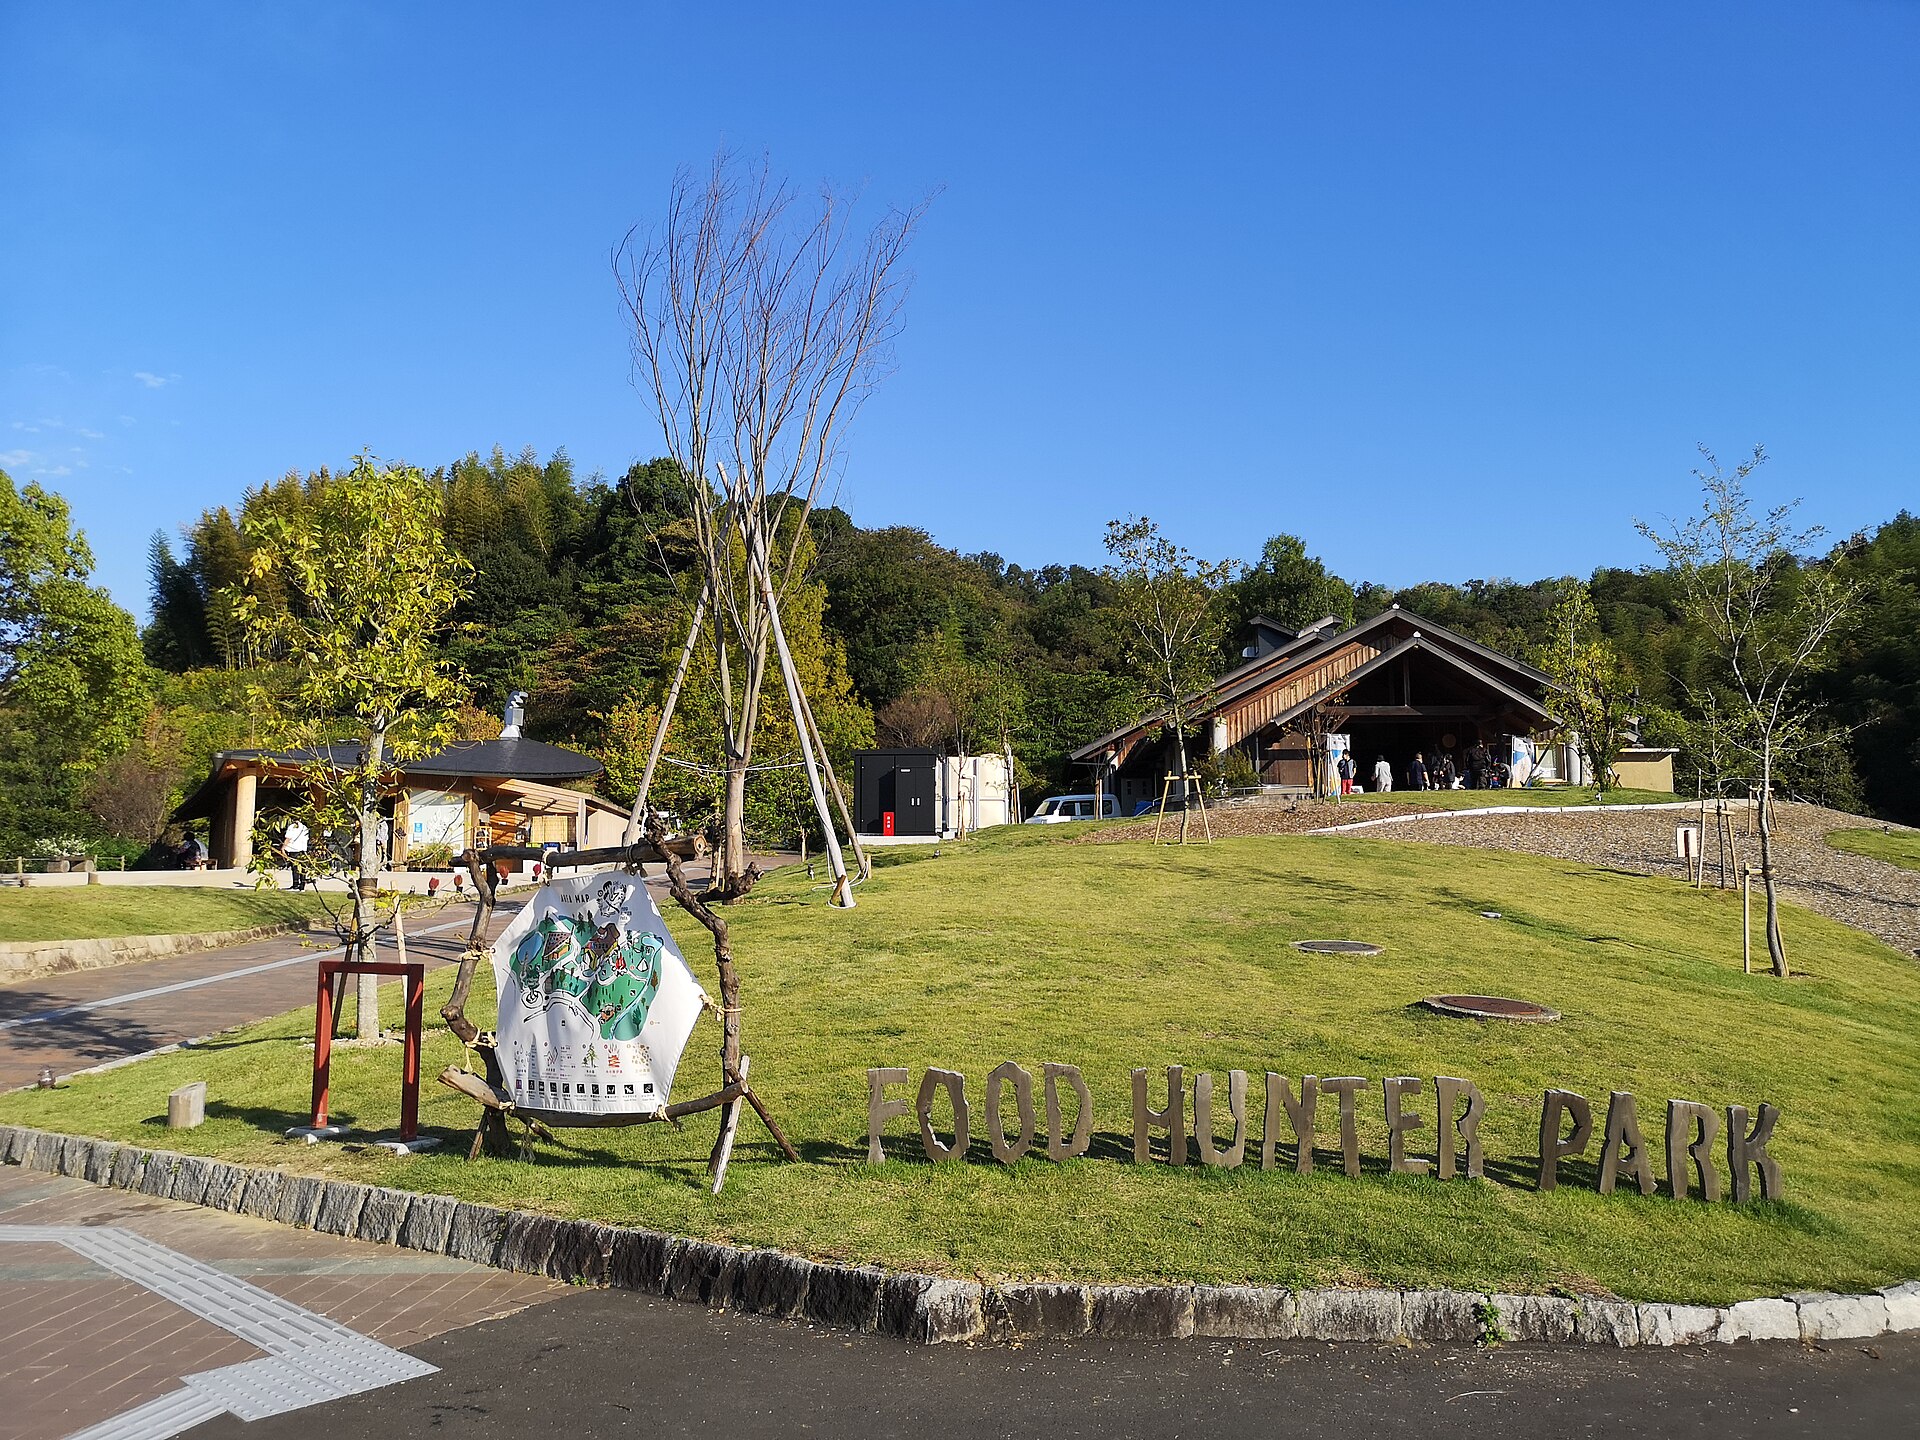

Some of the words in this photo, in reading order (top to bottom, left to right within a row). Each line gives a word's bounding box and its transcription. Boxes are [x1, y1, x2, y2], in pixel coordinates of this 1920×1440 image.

[574, 893, 590, 903] MAP
[867, 1060, 1093, 1164] FOOD
[1131, 1065, 1486, 1180] HUNTER
[1538, 1088, 1783, 1204] PARK
